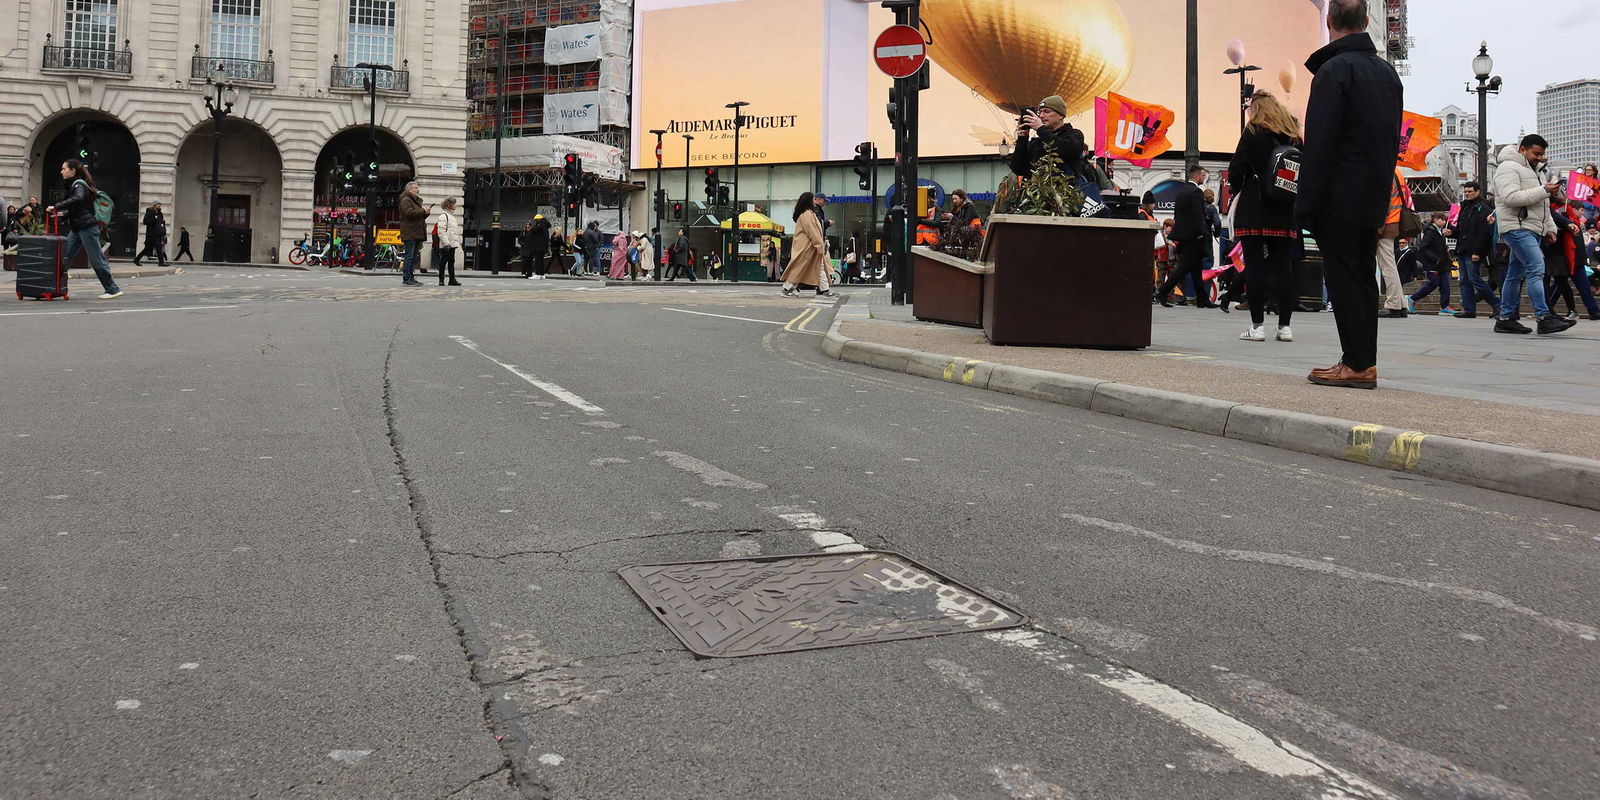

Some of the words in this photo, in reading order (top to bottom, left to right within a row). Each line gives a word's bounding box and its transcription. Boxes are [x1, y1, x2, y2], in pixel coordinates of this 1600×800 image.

[562, 40, 588, 50] Wates
[560, 109, 587, 118] Wates
[1119, 101, 1161, 128] PAY
[746, 114, 798, 129] PIGUET
[966, 191, 995, 204] eauty
[1574, 183, 1594, 200] UP
[1080, 200, 1105, 218] adidas
